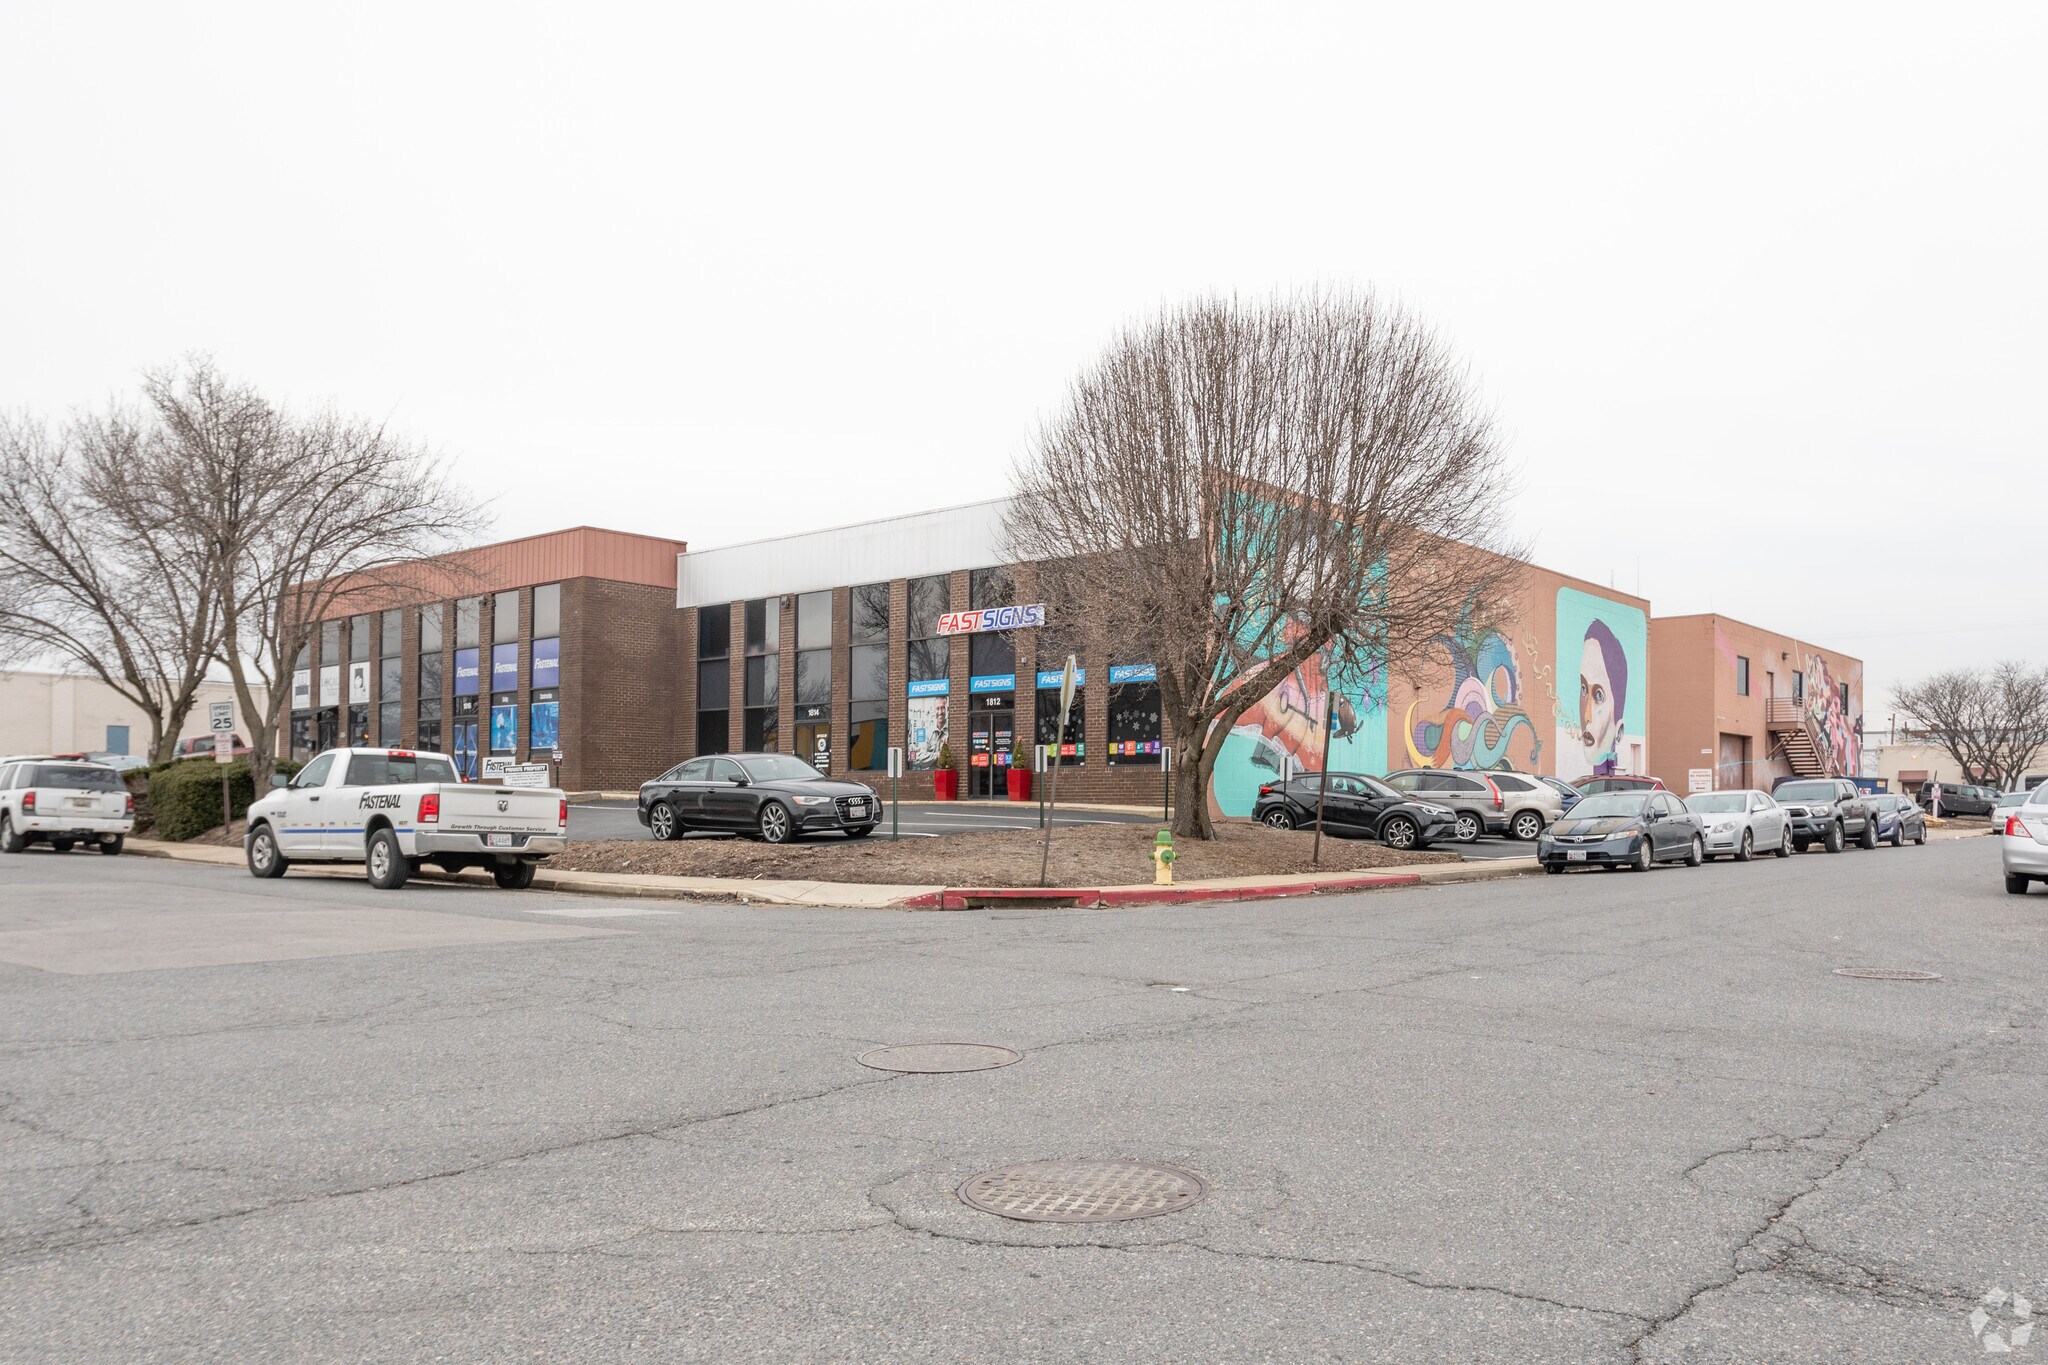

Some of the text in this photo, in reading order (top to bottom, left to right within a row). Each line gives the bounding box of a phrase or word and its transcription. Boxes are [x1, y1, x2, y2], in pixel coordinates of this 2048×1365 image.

[938, 605, 1038, 632] FASTSIGNS
[494, 662, 518, 673] FASTENAL
[534, 658, 559, 669] FASTENAL
[911, 683, 947, 693] FASTSIGNS
[974, 678, 1012, 688] FASTSIGNS
[986, 697, 1001, 706] 1812
[213, 717, 232, 729] 25
[359, 792, 402, 809] FASTENAL
